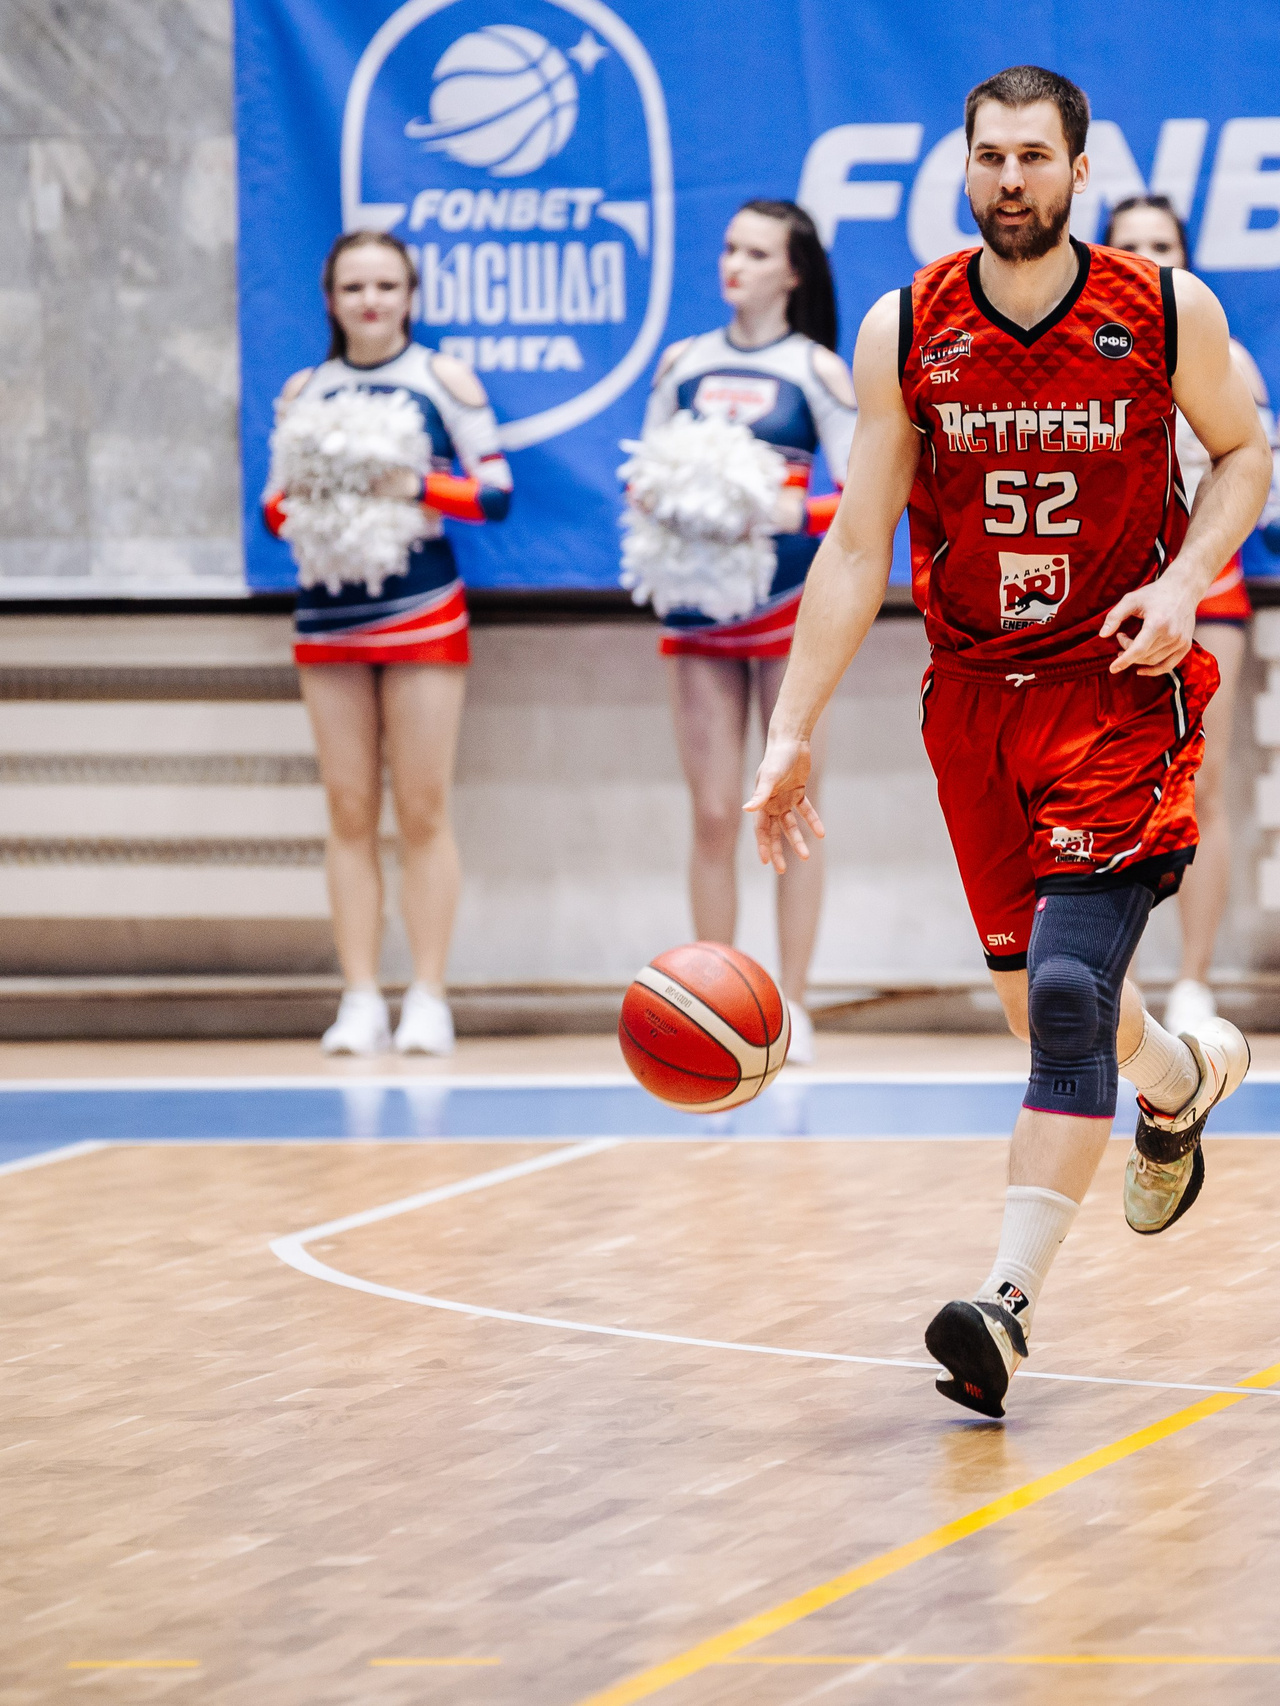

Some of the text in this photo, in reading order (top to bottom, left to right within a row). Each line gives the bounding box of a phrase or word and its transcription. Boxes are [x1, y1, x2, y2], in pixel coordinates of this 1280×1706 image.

[408, 186, 604, 233] FONBET
[1099, 335, 1128, 347] РФБ
[930, 368, 960, 384] STK
[964, 401, 1084, 411] ЧЕБОКСАРЫ
[931, 399, 1133, 453] ЯСТРЕБЫ
[984, 470, 1081, 536] 52
[1004, 564, 1050, 582] РАДИО
[987, 931, 1016, 946] STK
